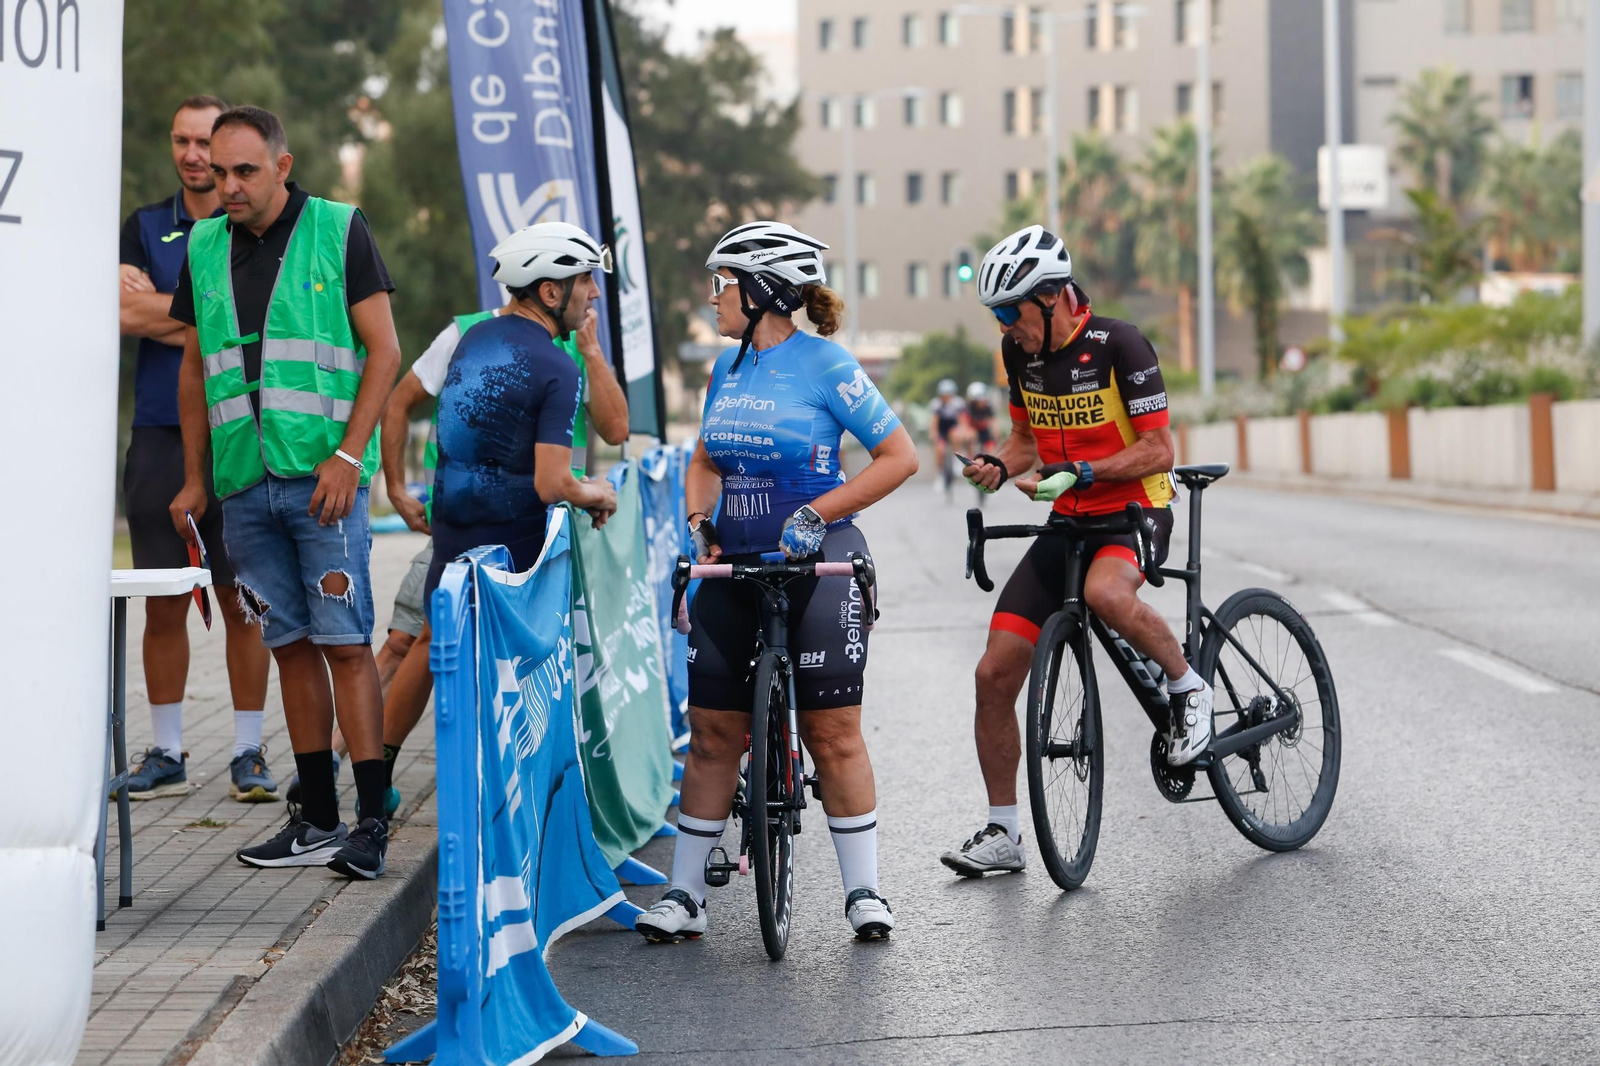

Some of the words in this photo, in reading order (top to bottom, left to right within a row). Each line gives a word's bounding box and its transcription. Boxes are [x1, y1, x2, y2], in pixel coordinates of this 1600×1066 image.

[751, 272, 774, 297] ENIN
[1027, 394, 1104, 411] ANDALUCIA
[1129, 397, 1166, 410] ANDALUCIA
[1130, 402, 1167, 416] NATURE
[1029, 408, 1105, 427] NATURE
[710, 432, 775, 446] COPRASA
[816, 445, 832, 475] BH
[839, 600, 848, 629] clínica
[800, 650, 826, 665] BH
